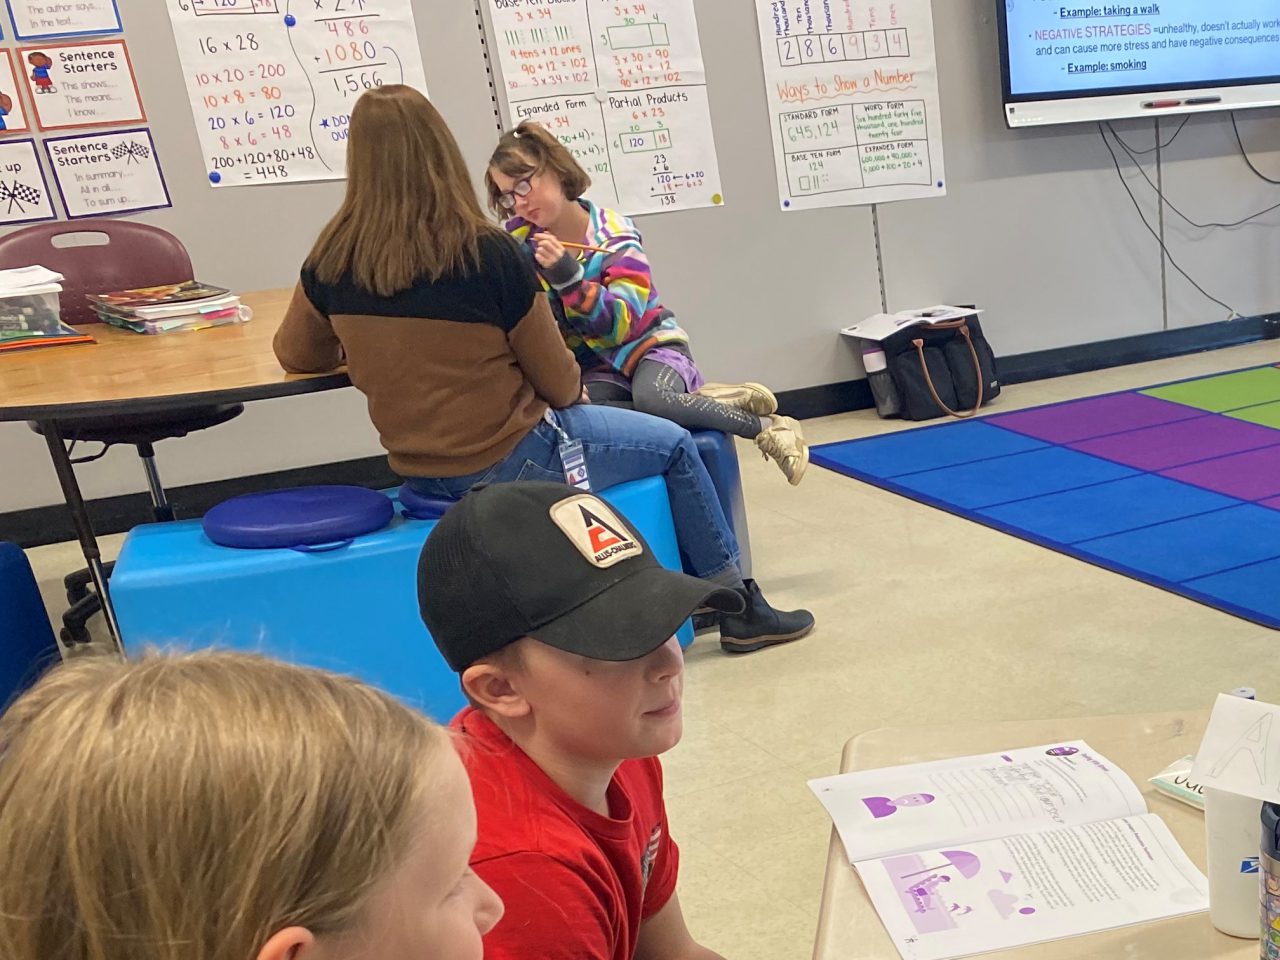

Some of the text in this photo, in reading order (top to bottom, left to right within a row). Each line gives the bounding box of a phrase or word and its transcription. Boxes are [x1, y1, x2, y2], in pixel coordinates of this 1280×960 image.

[1060, 7, 1101, 18] Example:
[1104, 5, 1131, 16] taking
[1140, 4, 1160, 14] walk
[1034, 28, 1082, 41] NEGATIVE
[1085, 23, 1150, 38] STRATEGIES
[1200, 20, 1229, 32] doesn't
[1231, 19, 1260, 31] actually
[1262, 18, 1280, 28] work
[199, 37, 217, 55] 16
[236, 33, 259, 50] 28
[1036, 34, 1279, 56] and can cause more stress and have negative consequences
[60, 50, 115, 62] Sentence
[64, 61, 117, 74] Starters
[196, 73, 209, 86] 10
[224, 69, 244, 82] 20
[258, 64, 286, 79] 200
[1068, 60, 1147, 74] Example: smoking
[777, 68, 915, 103] Ways to Show a Number
[204, 95, 218, 108] 10
[234, 90, 244, 104] 8
[261, 86, 281, 100] 80
[609, 92, 688, 109] Partial Products
[516, 99, 586, 118] Expanded Form
[783, 107, 839, 122] STANDARD FORM
[208, 117, 226, 130] 20
[245, 111, 254, 125] 6
[270, 104, 295, 120] 120
[220, 136, 230, 150] 8
[248, 132, 257, 146] 6
[272, 124, 292, 139] 48
[629, 138, 644, 148] 120
[53, 141, 108, 156] Sentence
[5, 162, 22, 174] up
[58, 153, 111, 167] Starters
[256, 165, 288, 179] 448
